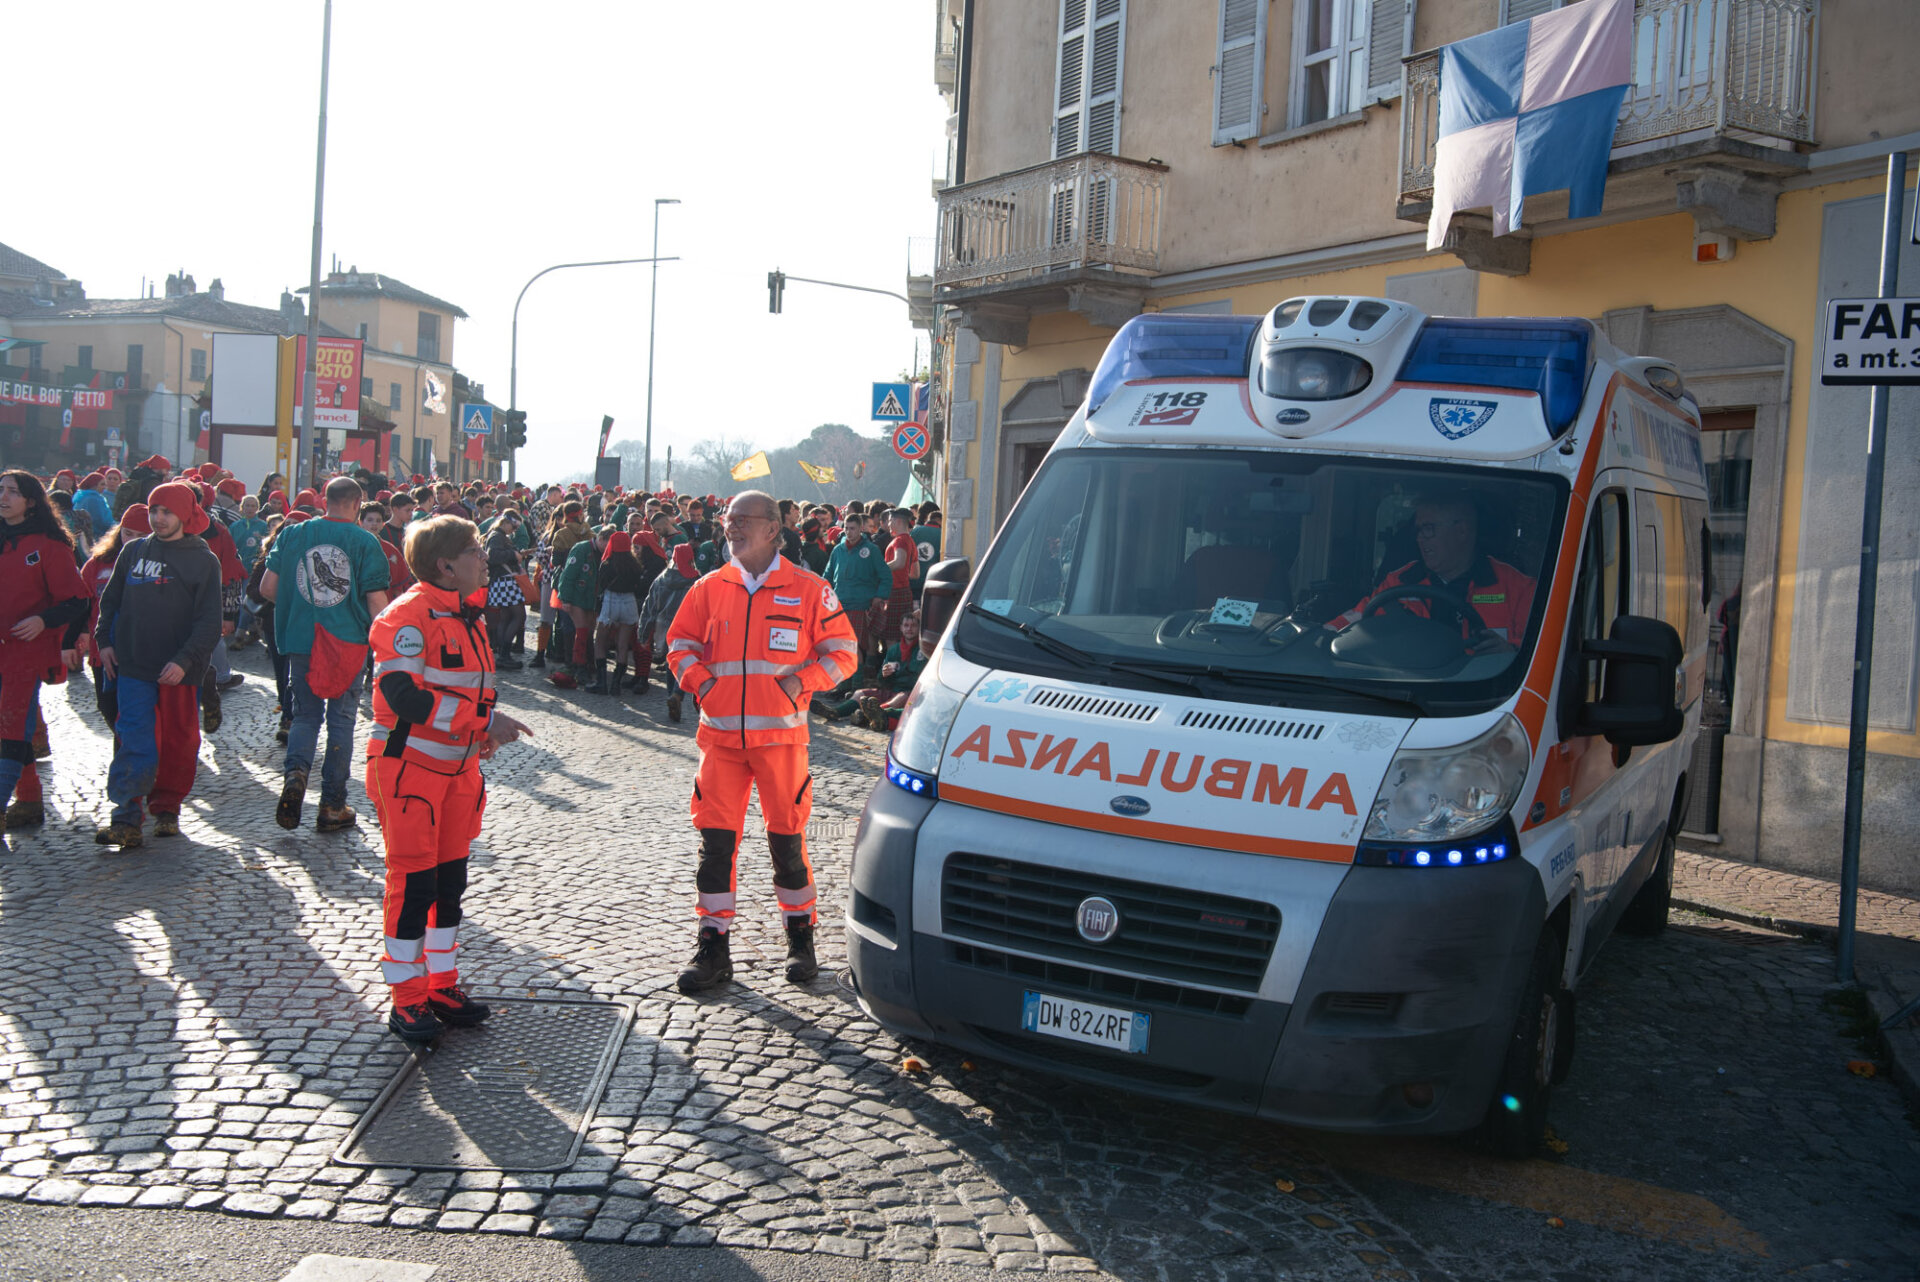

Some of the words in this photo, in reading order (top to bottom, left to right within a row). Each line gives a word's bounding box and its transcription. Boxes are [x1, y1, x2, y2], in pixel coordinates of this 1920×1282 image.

[316, 347, 354, 364] OTTO
[1833, 353, 1849, 368] a
[315, 363, 353, 379] OSTO
[13, 383, 35, 402] DEL
[1152, 391, 1209, 407] 118
[1448, 398, 1480, 406] IVREA
[1084, 907, 1112, 933] FIAT
[1040, 1000, 1064, 1029] DW
[1068, 1008, 1131, 1042] 824RF
